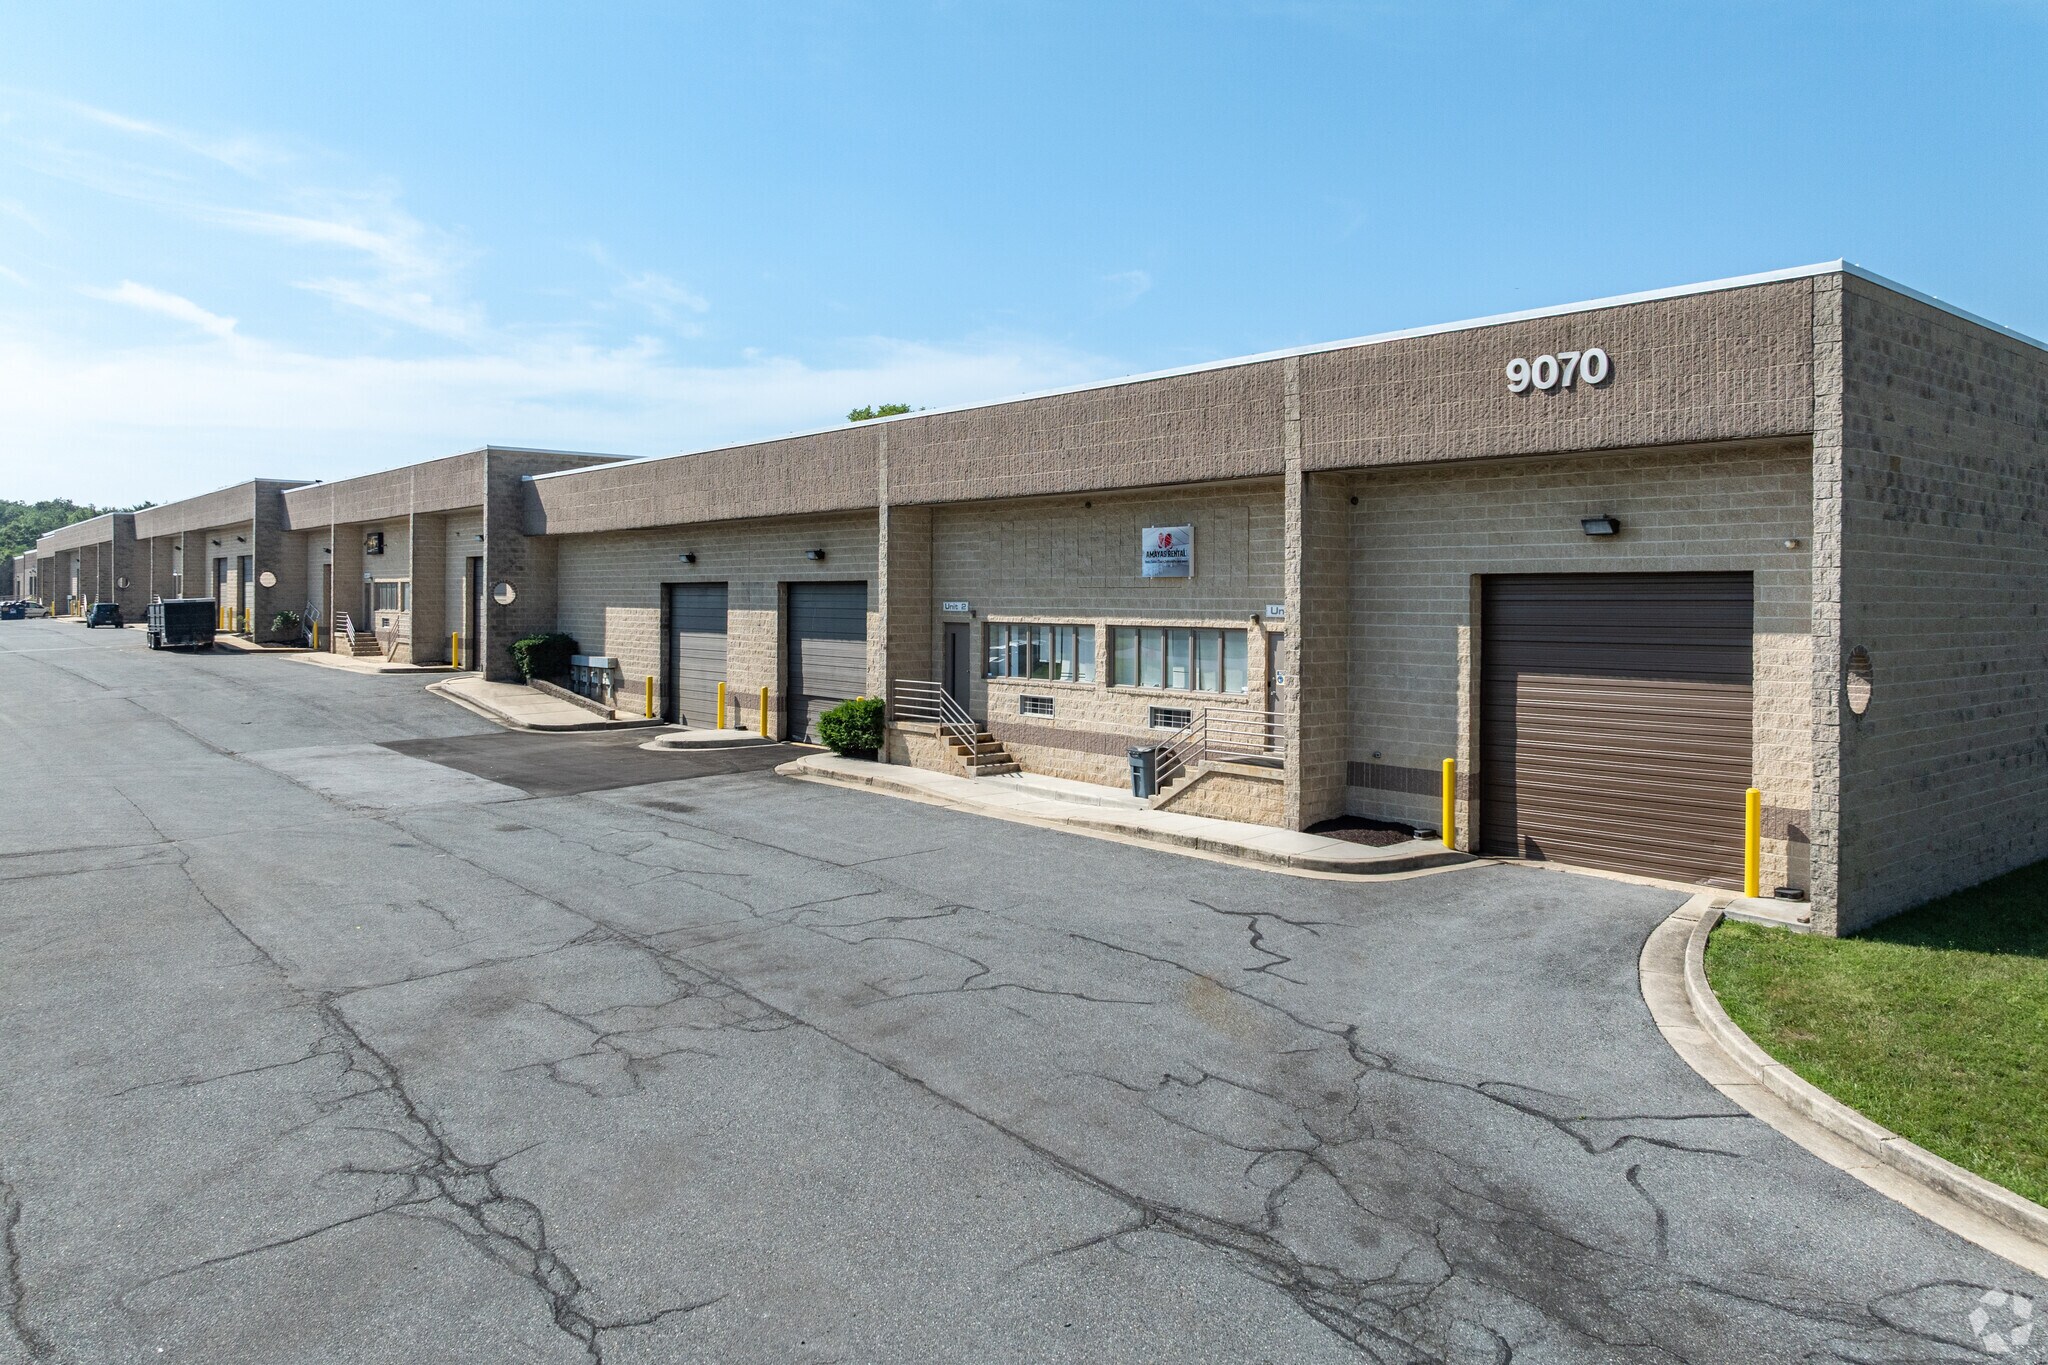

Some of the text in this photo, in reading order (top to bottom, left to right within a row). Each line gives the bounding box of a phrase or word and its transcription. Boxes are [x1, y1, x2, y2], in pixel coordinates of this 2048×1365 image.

[1506, 347, 1609, 393] 9070
[1146, 549, 1187, 558] AMAYAS RENTAL
